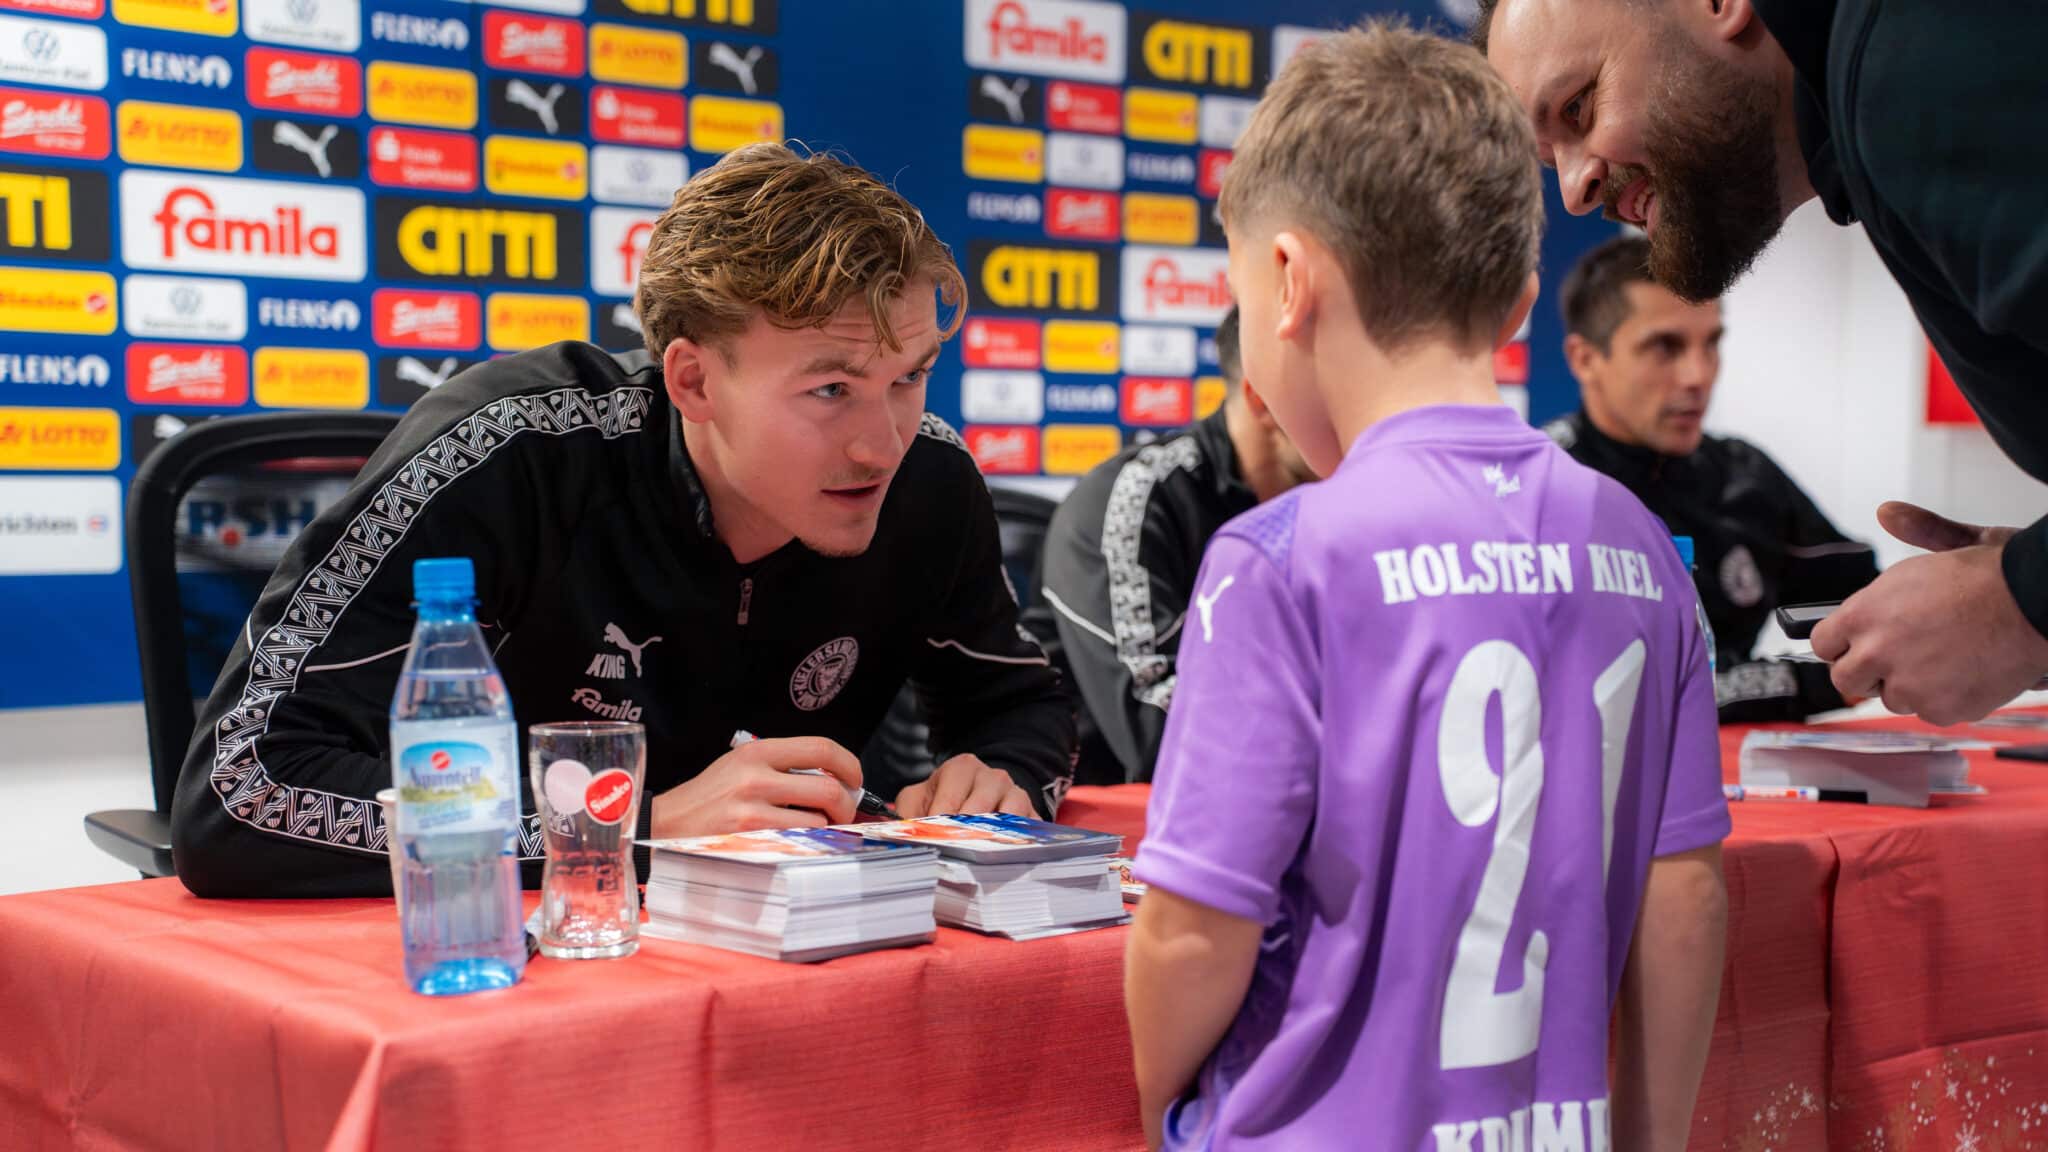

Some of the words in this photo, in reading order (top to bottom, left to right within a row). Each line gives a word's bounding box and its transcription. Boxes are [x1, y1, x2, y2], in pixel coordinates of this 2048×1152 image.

[155, 187, 339, 259] famila
[1144, 258, 1234, 315] famil
[1587, 544, 1662, 602] KIEL
[585, 653, 625, 679] KING
[571, 688, 642, 721] famila
